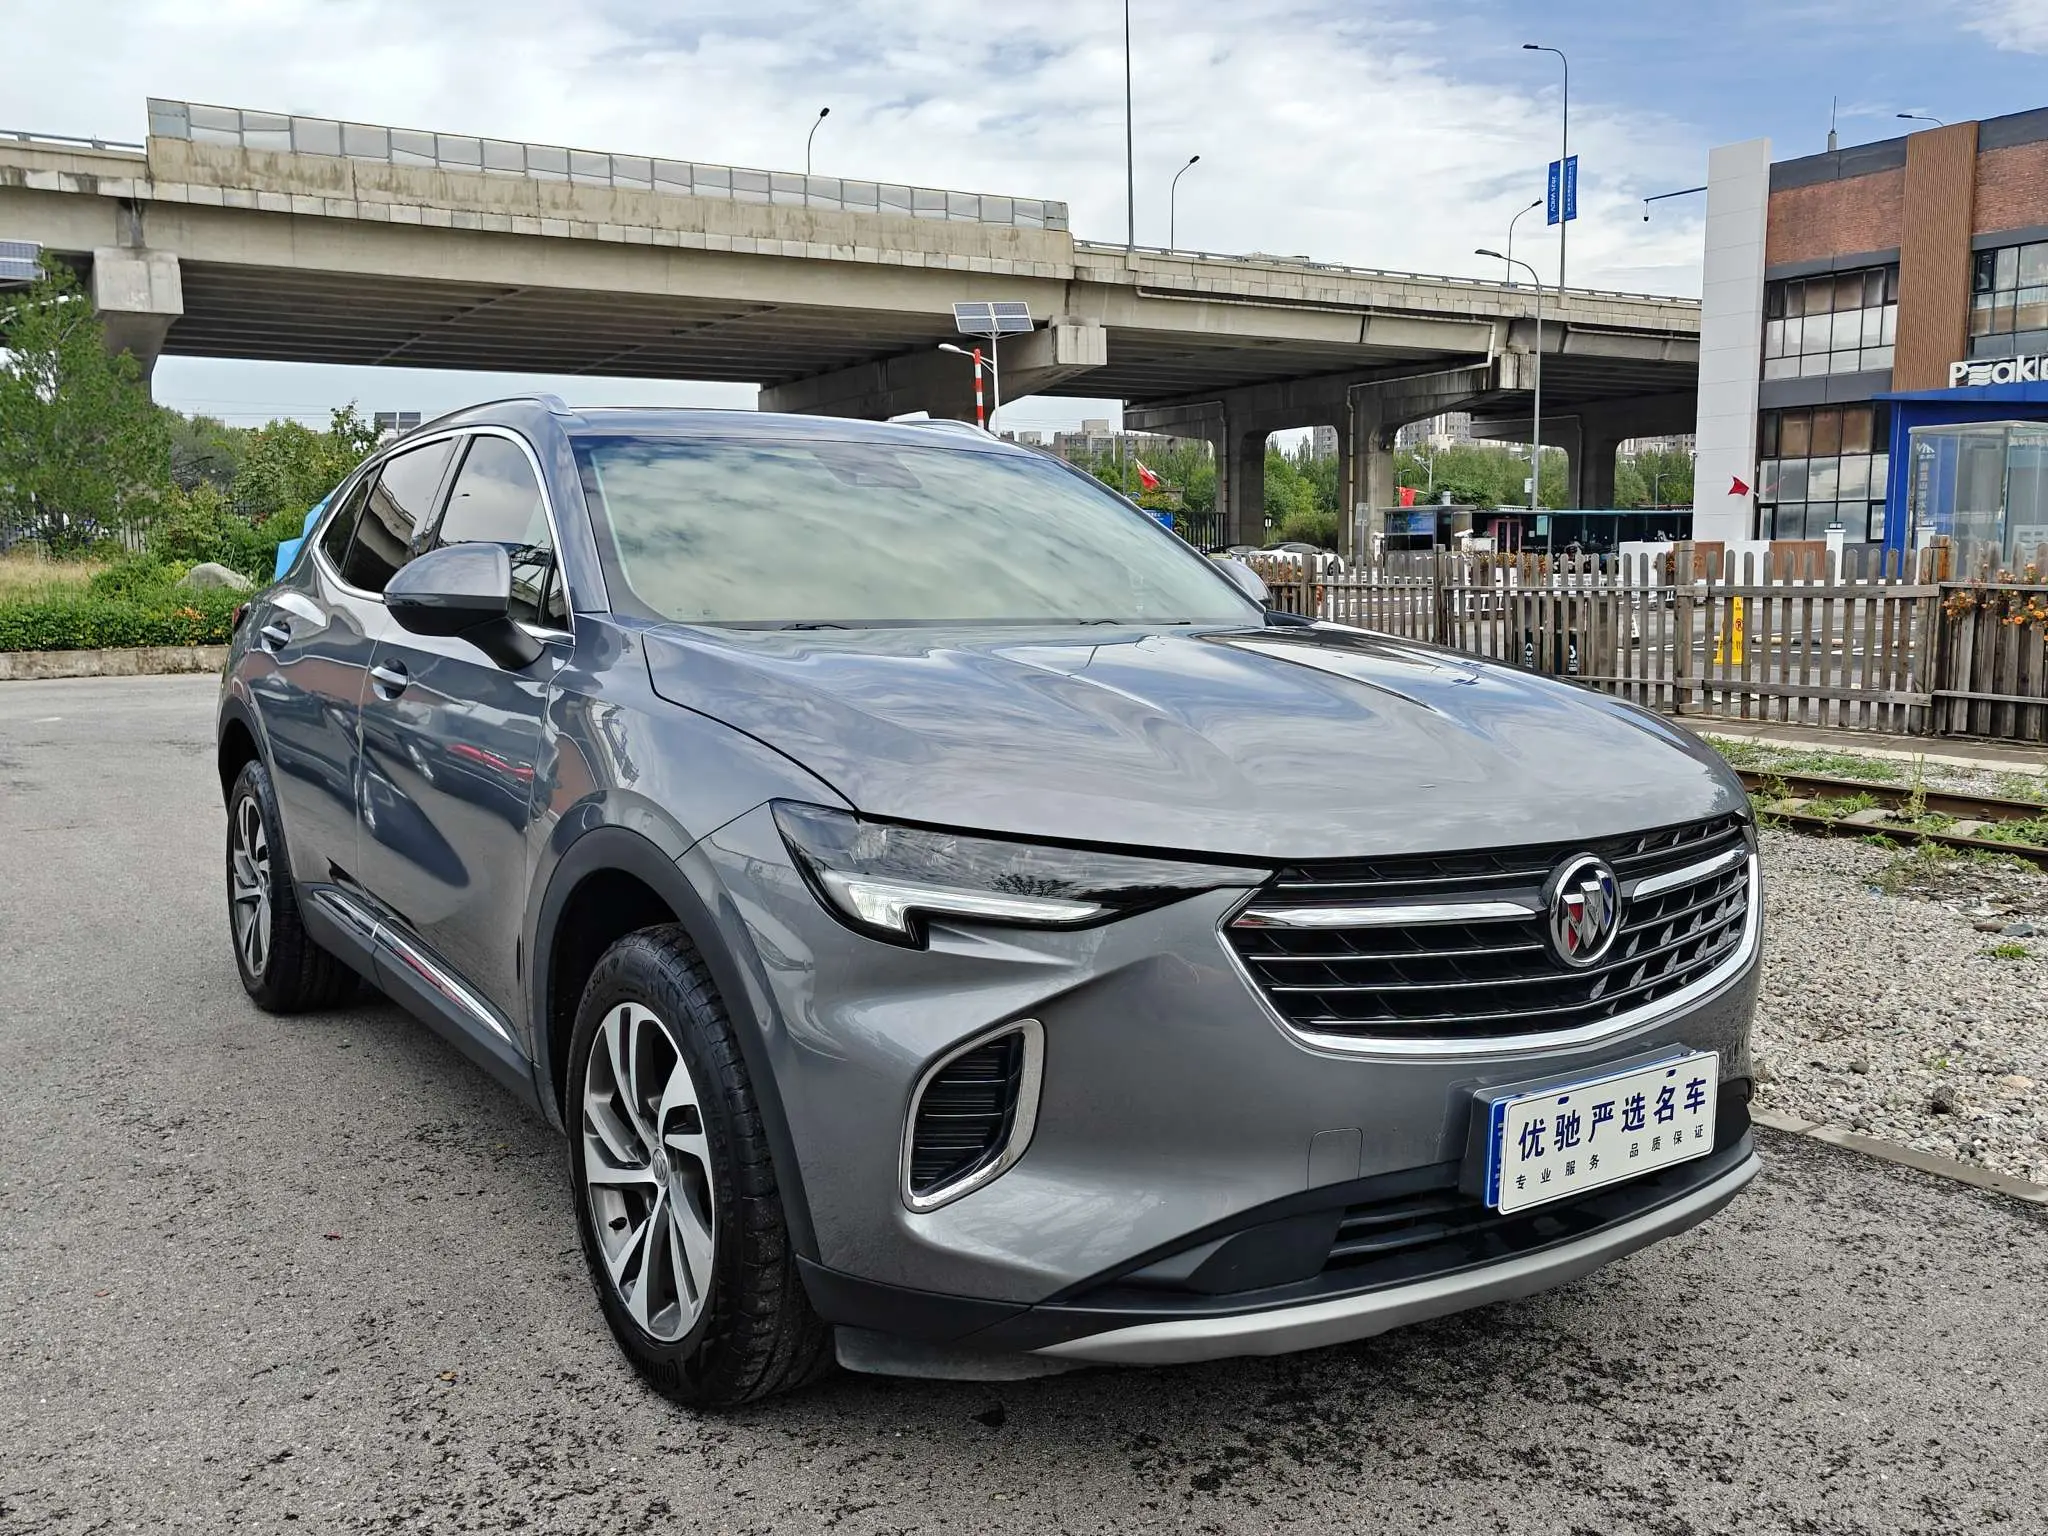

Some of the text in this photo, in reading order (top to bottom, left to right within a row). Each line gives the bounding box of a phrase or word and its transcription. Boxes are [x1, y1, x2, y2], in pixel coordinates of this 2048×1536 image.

[1518, 1077, 1706, 1161] 优驰严选名车
[1515, 1154, 1600, 1190] 专业服务
[1629, 1124, 1704, 1158] 品质保证
